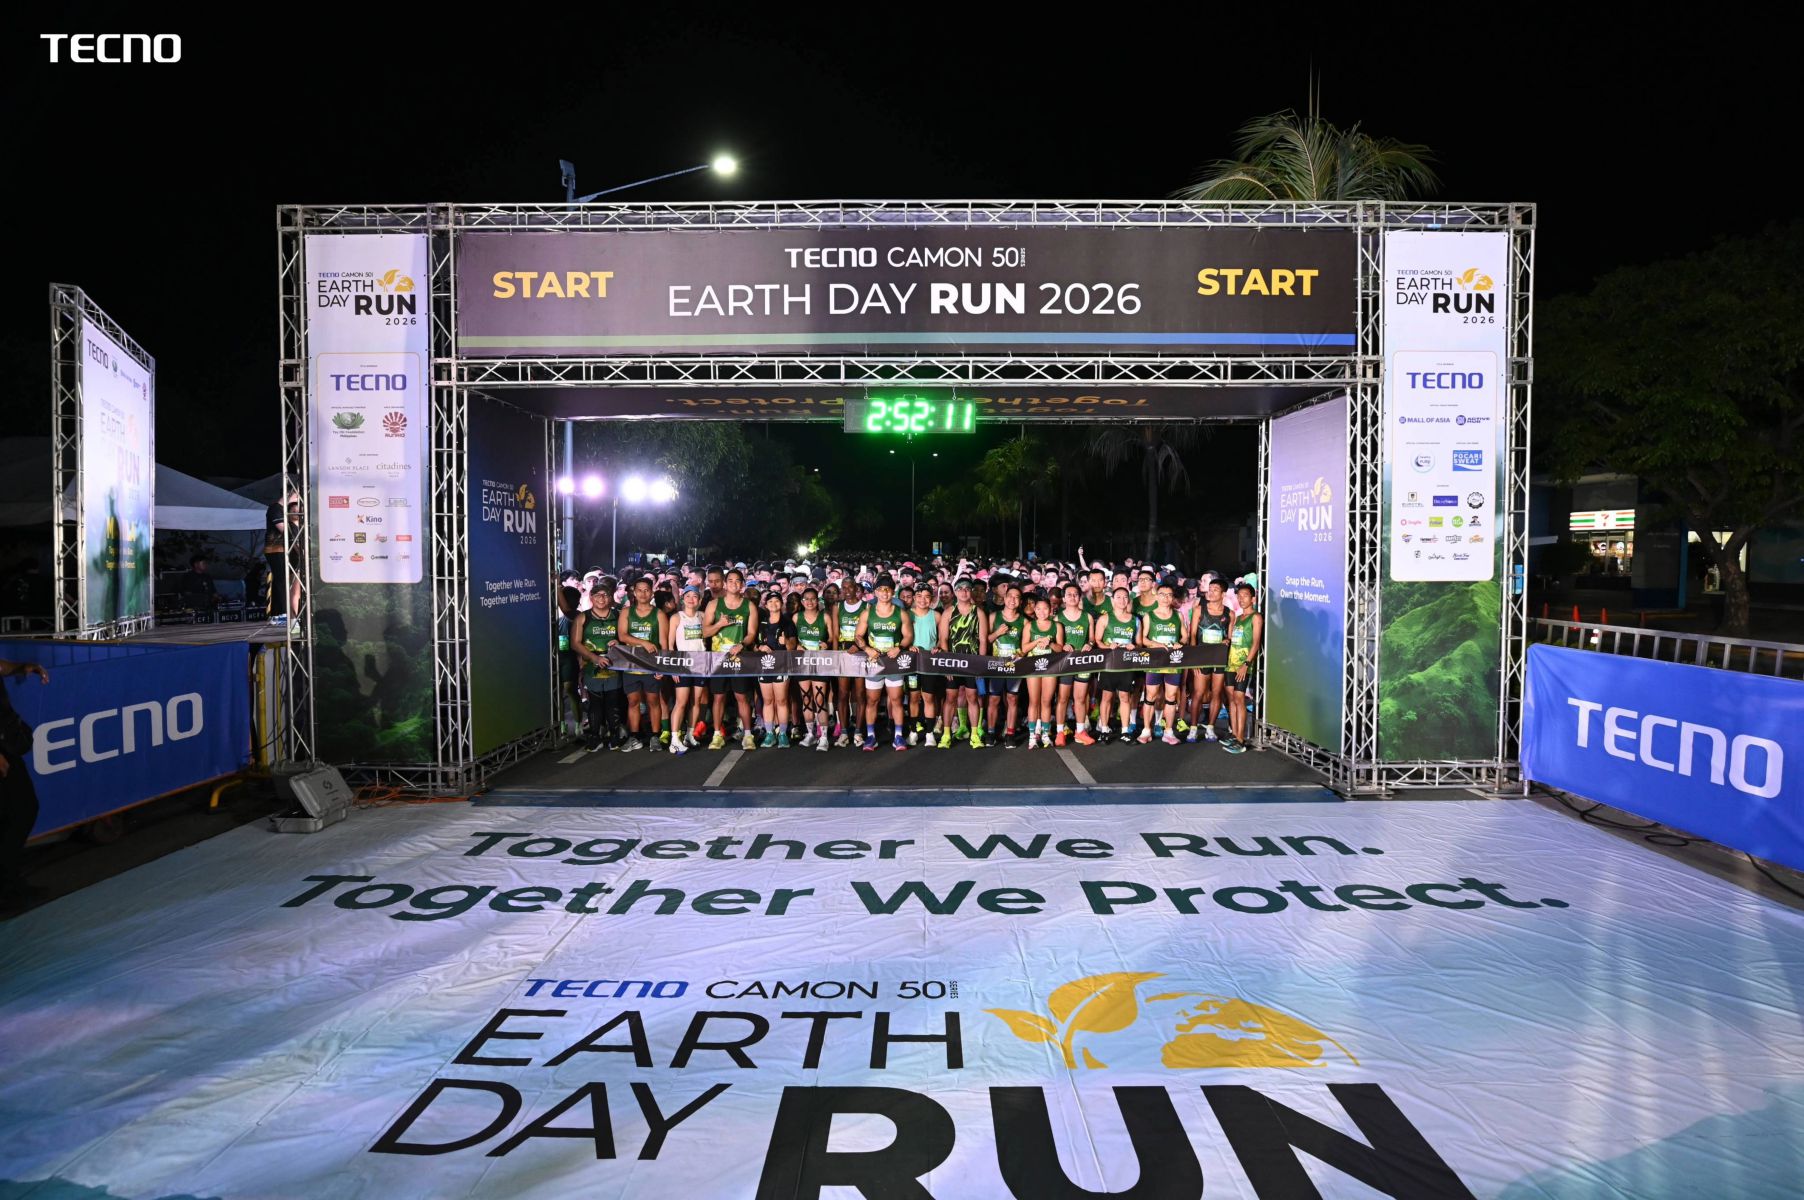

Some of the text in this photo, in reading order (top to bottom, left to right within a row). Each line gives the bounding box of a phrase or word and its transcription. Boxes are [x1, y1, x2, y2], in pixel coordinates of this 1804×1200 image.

[784, 246, 1020, 269] TECNO CAMON 50
[318, 280, 374, 293] EARTH
[492, 271, 614, 298] START
[1196, 267, 1319, 296] START
[1396, 277, 1453, 290] EARTH
[318, 294, 416, 316] DAY RUN
[668, 282, 1142, 317] EARTH DAY RUN 2026
[1396, 292, 1494, 314] DAY RUN
[386, 317, 416, 326] 2026
[1463, 316, 1494, 324] 2026
[330, 374, 407, 391] TECNO
[1406, 372, 1484, 390] TECNO
[867, 400, 974, 431] 2:52:11
[376, 462, 412, 470] citadines
[482, 489, 515, 508] EARTH
[1280, 489, 1310, 508] EARTH
[366, 515, 383, 523] Kino
[482, 506, 536, 534] DAY RUN
[1280, 504, 1333, 532] DAY RUN
[520, 535, 537, 544] 2026
[1314, 532, 1333, 542] 2026
[485, 580, 513, 593] Together
[514, 579, 524, 588] We
[1285, 575, 1300, 586] Snap
[1300, 576, 1310, 586] the
[480, 595, 508, 608] Together
[509, 593, 519, 603] We
[1280, 589, 1331, 604] Own the Moment.
[655, 656, 694, 667] TECNO
[795, 656, 833, 666] TECNO
[930, 657, 968, 668] TECNO
[1067, 654, 1104, 666] TECNO
[33, 692, 203, 775] ECNO
[1567, 697, 1784, 799] TECNO
[462, 831, 1385, 866] Together We Run.
[278, 874, 1570, 922] Together We Protect.
[525, 978, 946, 1000] TECNO CAMON 50
[451, 1007, 964, 1070] EARTH
[367, 1077, 1477, 1200] DAY RUN
